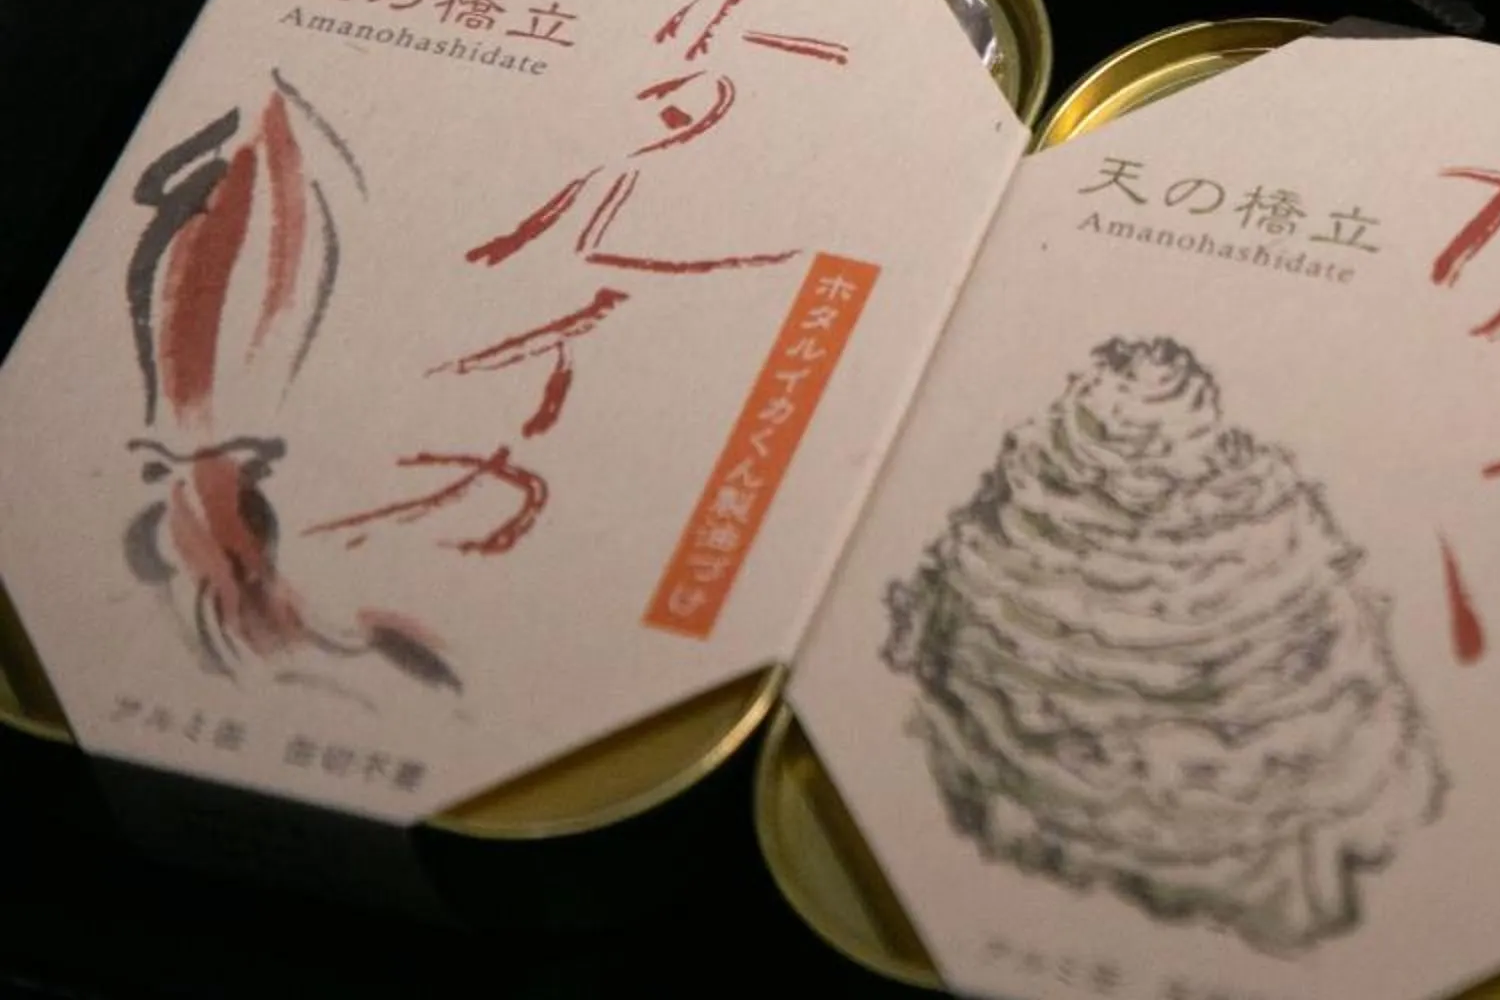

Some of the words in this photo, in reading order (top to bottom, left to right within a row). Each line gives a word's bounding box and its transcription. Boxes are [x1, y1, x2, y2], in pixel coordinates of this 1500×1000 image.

[278, 4, 548, 78] Amanohashidate
[1078, 155, 1382, 256] 天の橋立
[1076, 208, 1357, 286] Amanohashidate
